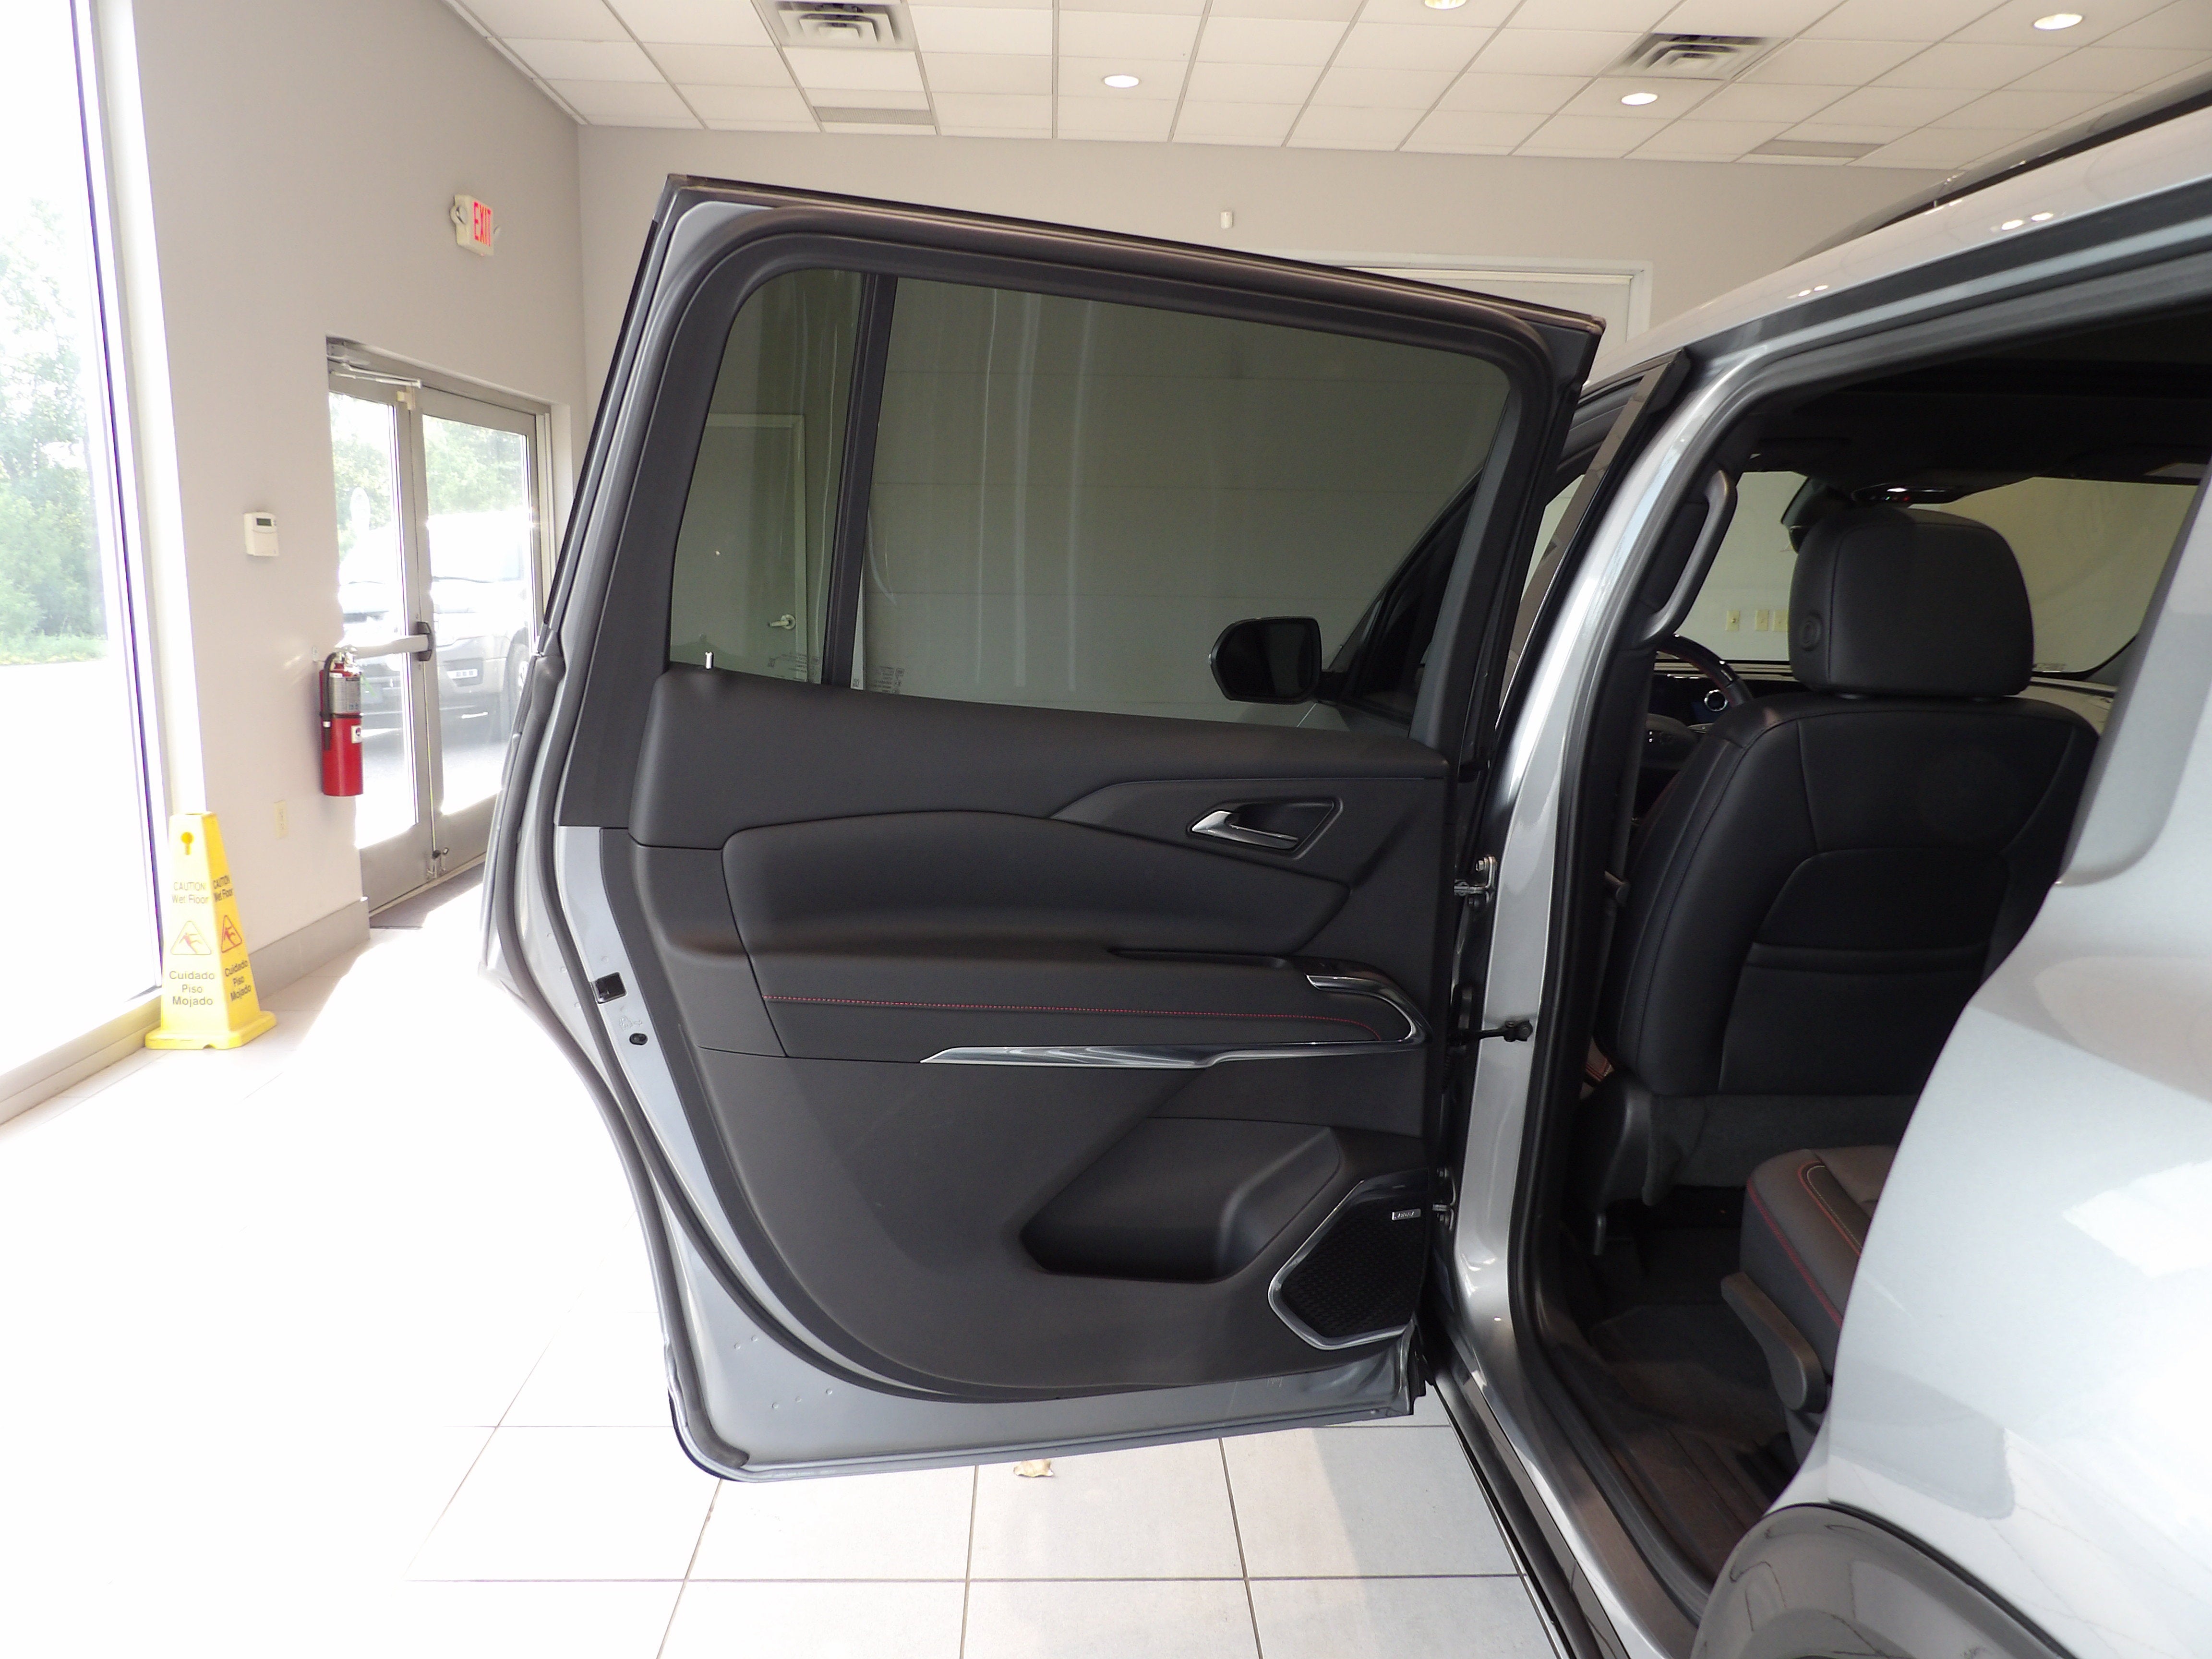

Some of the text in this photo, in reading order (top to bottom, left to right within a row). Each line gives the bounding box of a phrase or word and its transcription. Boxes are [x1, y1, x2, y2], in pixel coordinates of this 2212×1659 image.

[474, 202, 492, 247] EXIT
[173, 882, 206, 891] CAUTION
[172, 894, 208, 903] Wet Floor
[225, 960, 248, 977] Cuidado
[169, 971, 215, 980] Cuidado
[233, 976, 244, 987] Piso
[181, 984, 203, 993] Piso
[230, 985, 252, 1001] Mojado
[172, 996, 213, 1008] Mojado
